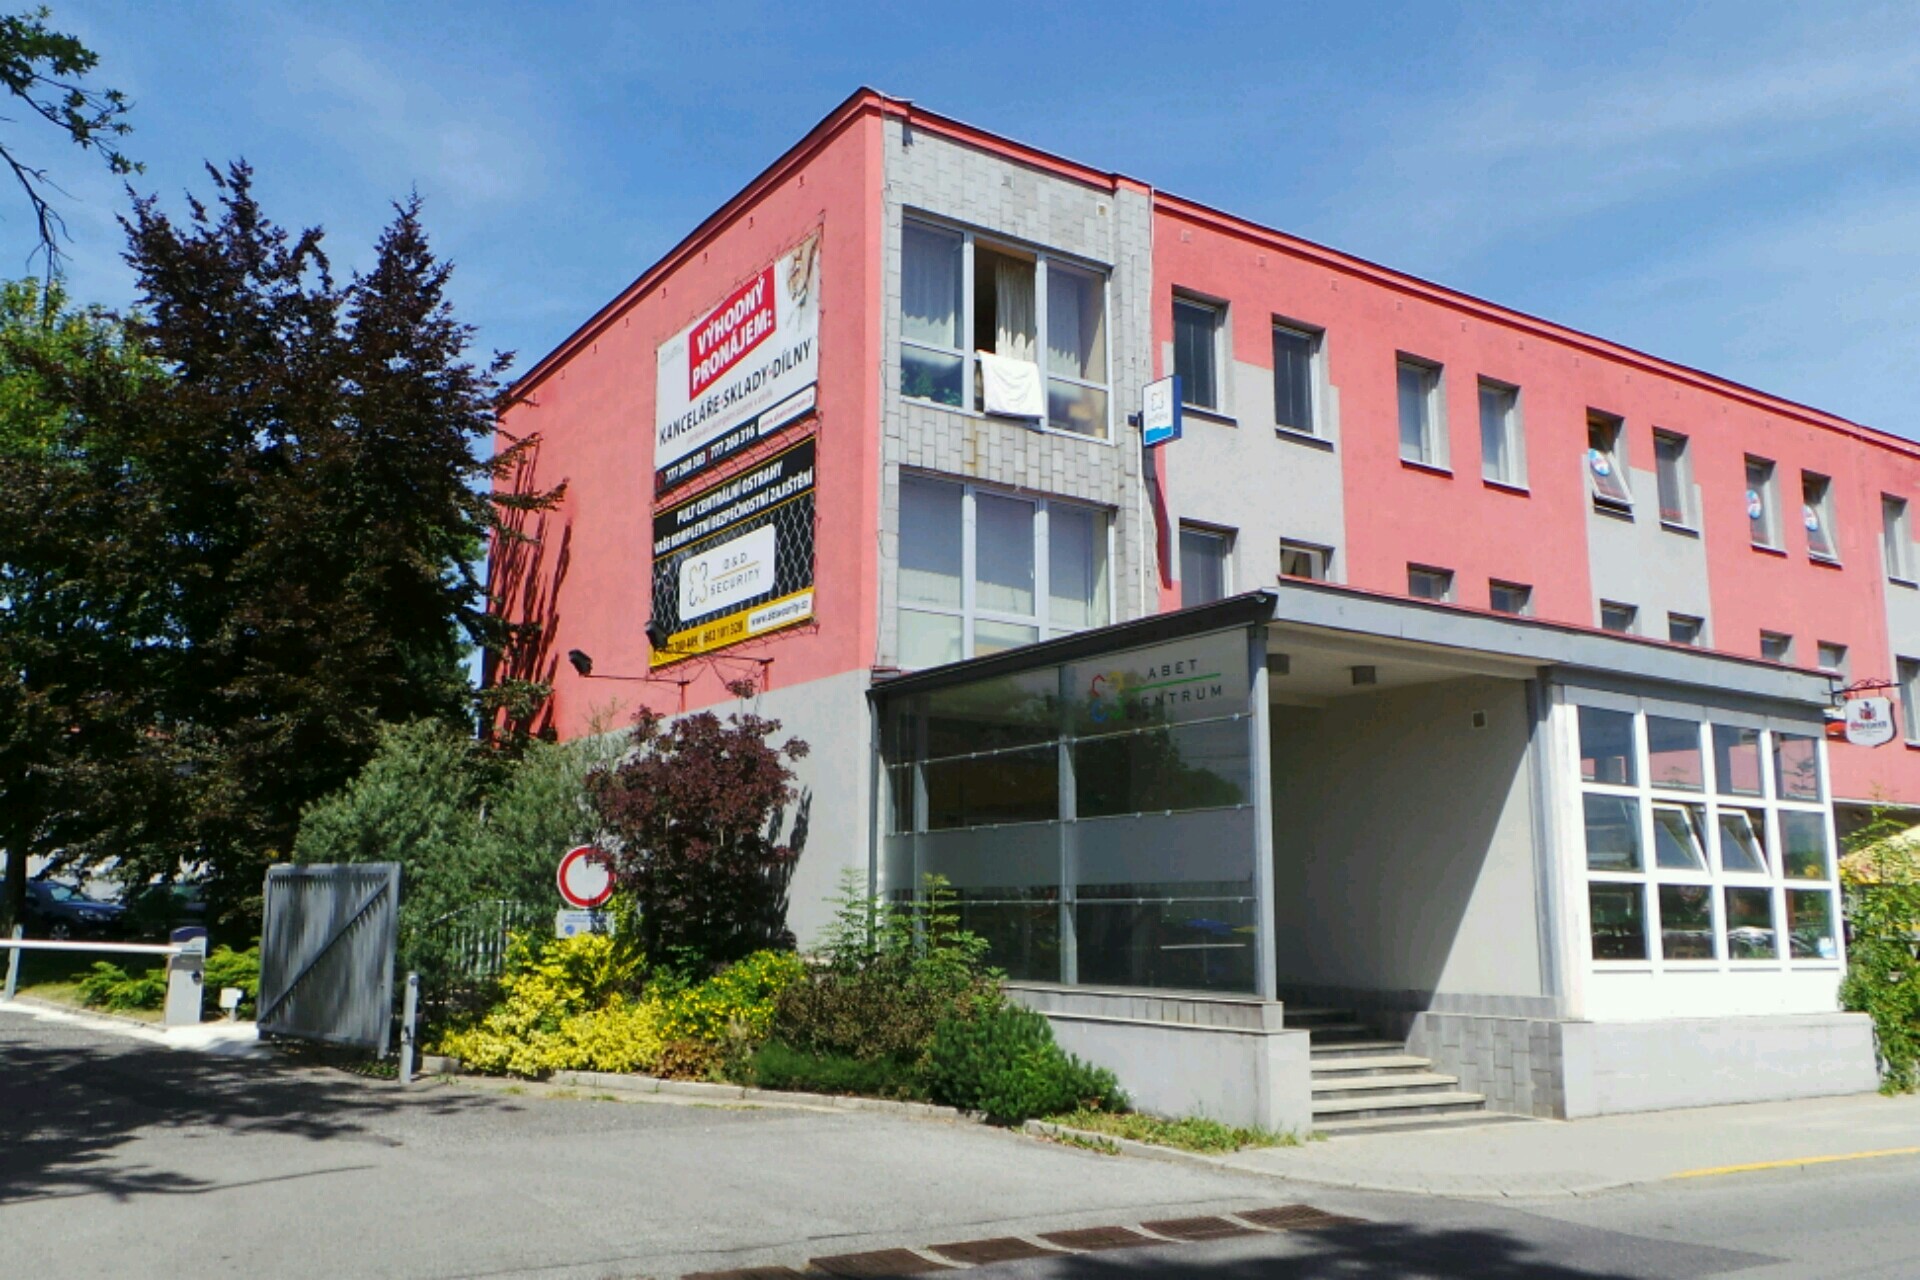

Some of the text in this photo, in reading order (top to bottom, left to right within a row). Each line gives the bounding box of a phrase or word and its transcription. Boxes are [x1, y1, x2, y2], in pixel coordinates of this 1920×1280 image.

[697, 274, 765, 355] VÝHODNÝ
[693, 308, 772, 390] PRONÁJEM:
[710, 567, 760, 596] SECURITY
[1147, 659, 1198, 680] ABET
